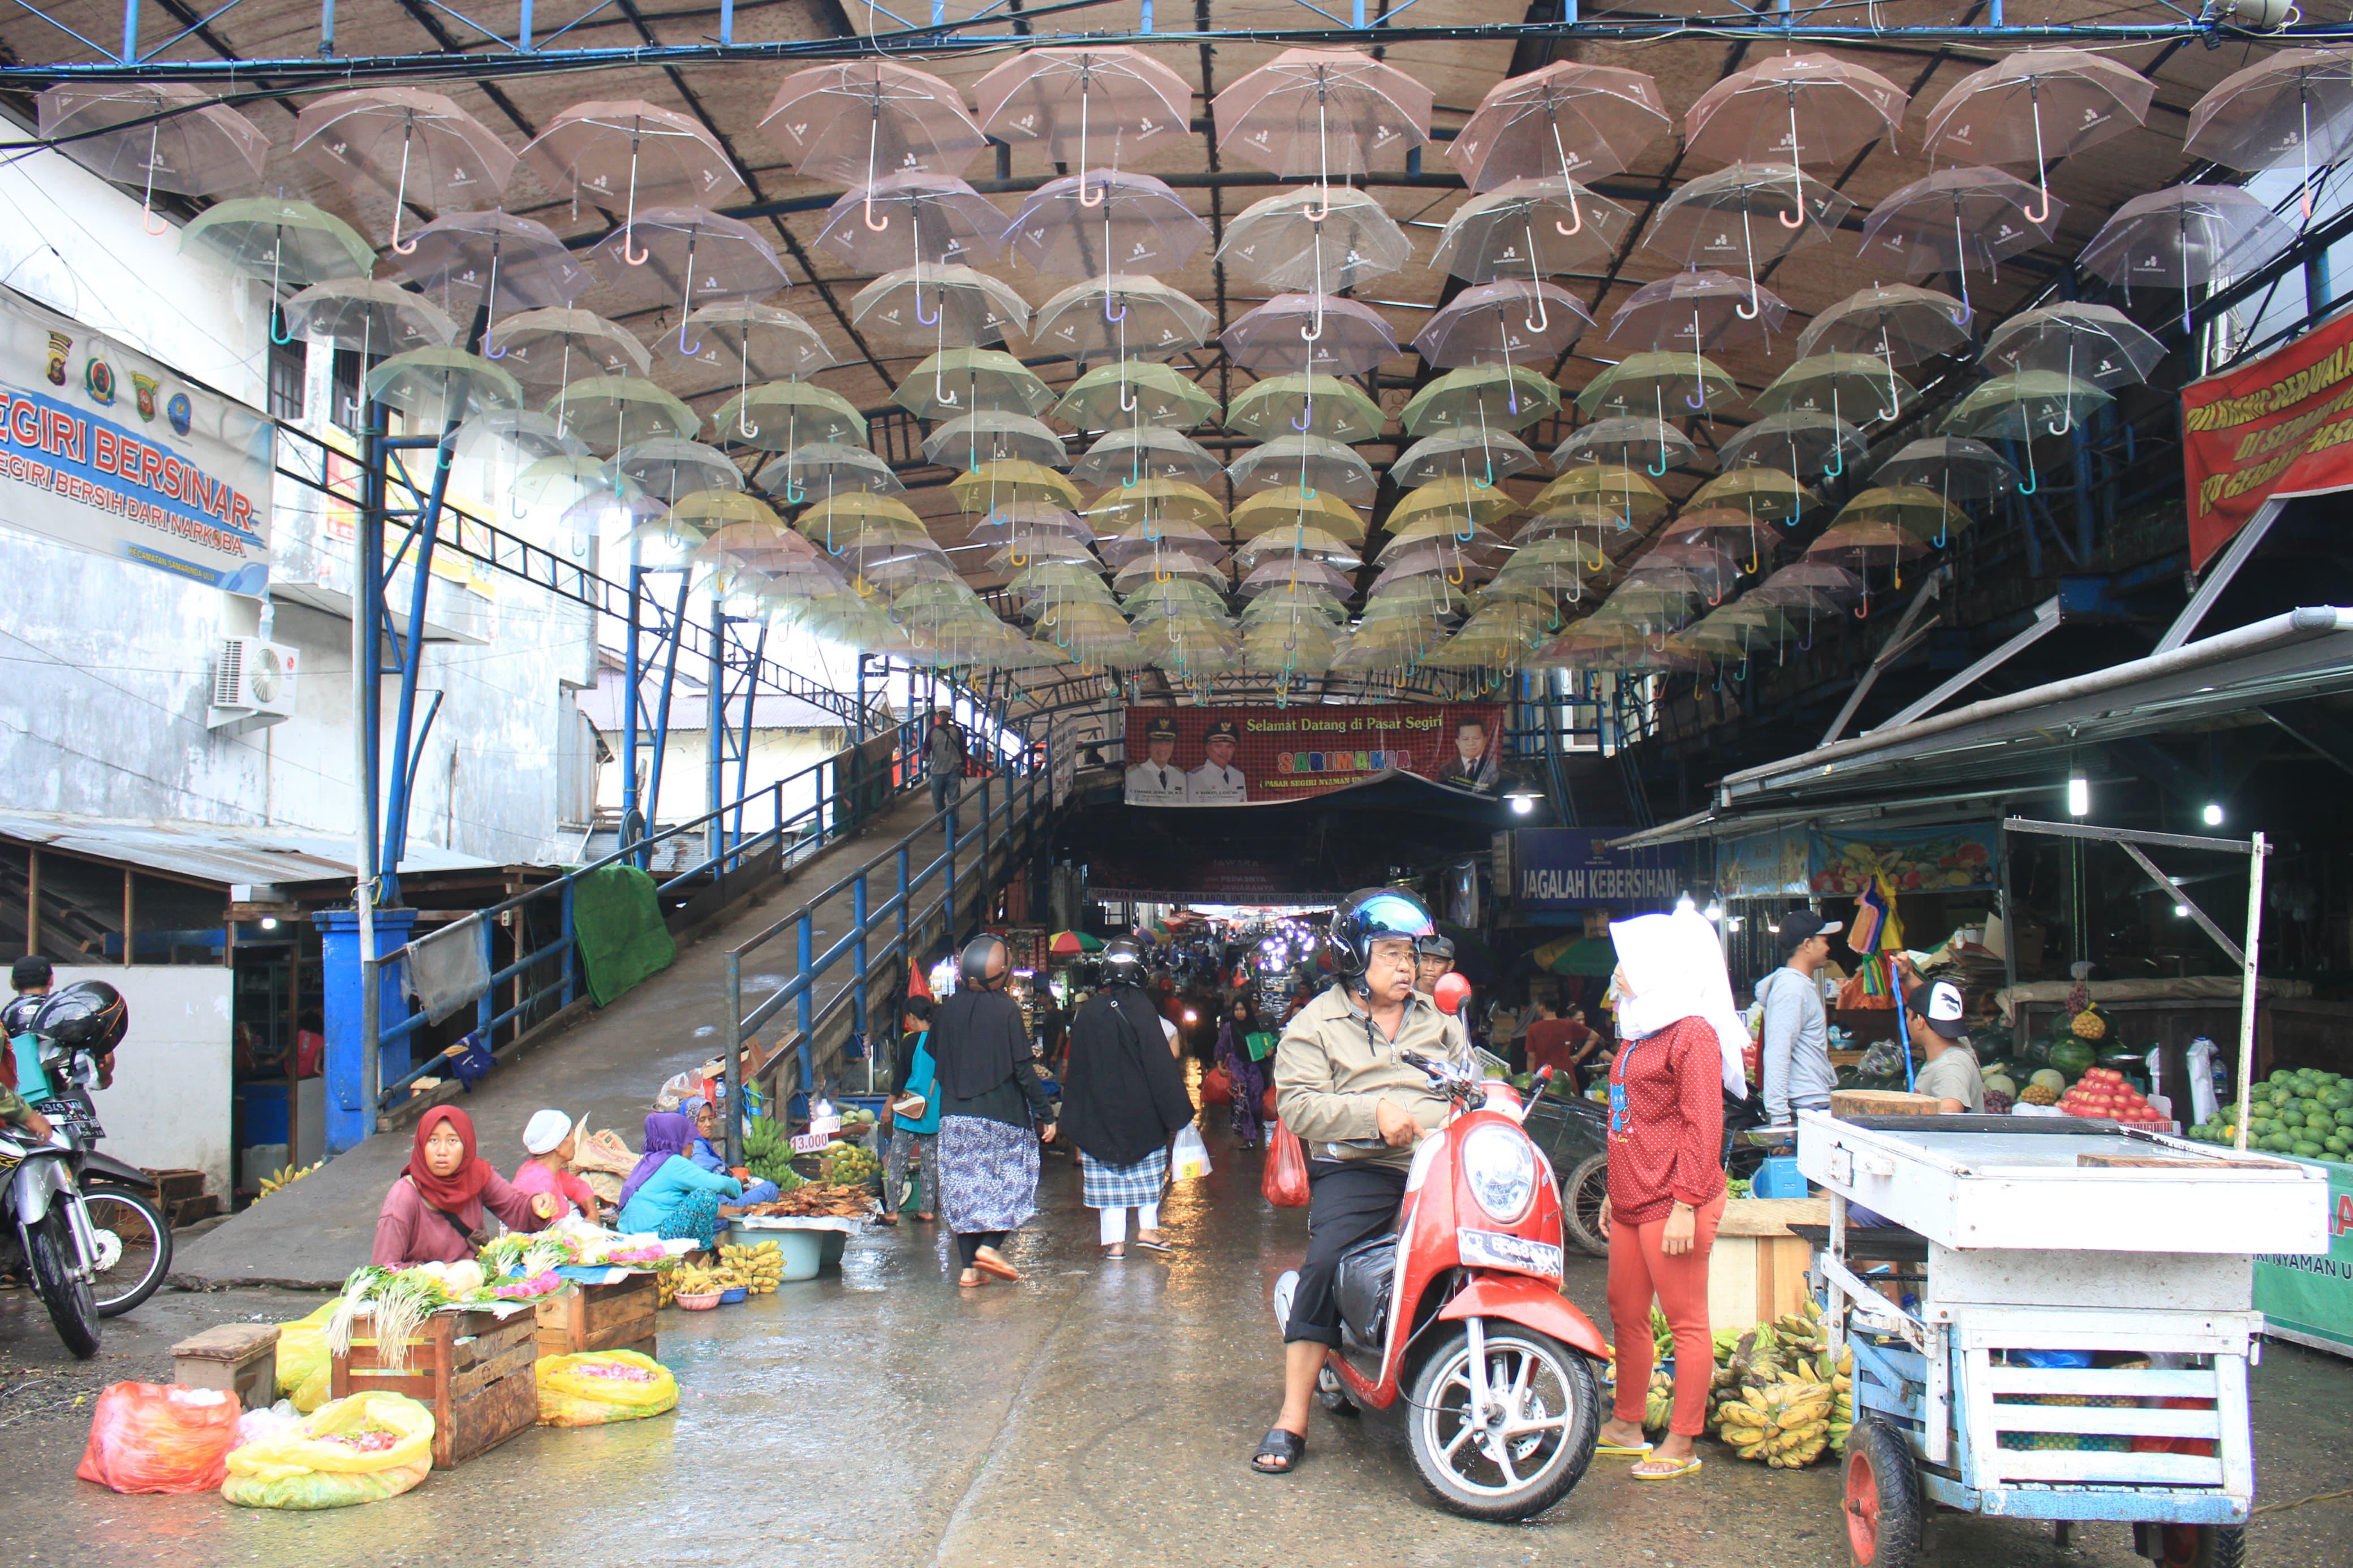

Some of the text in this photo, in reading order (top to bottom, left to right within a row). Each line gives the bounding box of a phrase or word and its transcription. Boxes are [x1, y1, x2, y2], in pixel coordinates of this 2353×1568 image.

[94, 424, 253, 534] BERSINAR
[55, 473, 125, 517] BERSIH
[127, 497, 168, 530] DARI
[170, 511, 246, 556] NARKOBA
[128, 546, 216, 582] KECAMATAN SAMARINDA ULU
[1247, 715, 1443, 733] Selamat Datang di Pasar Segiri
[1278, 749, 1412, 774] SARIMANJA
[1521, 868, 1677, 899] JAGALAH KEBERSIHAN
[1132, 891, 1168, 901] KANTONG
[1170, 892, 1204, 901] BELANJA
[1230, 893, 1255, 902] UNTUK
[1257, 893, 1309, 903] MENGURANGI
[791, 1134, 828, 1151] 13.000
[2272, 1254, 2336, 1277] NYAMAN
